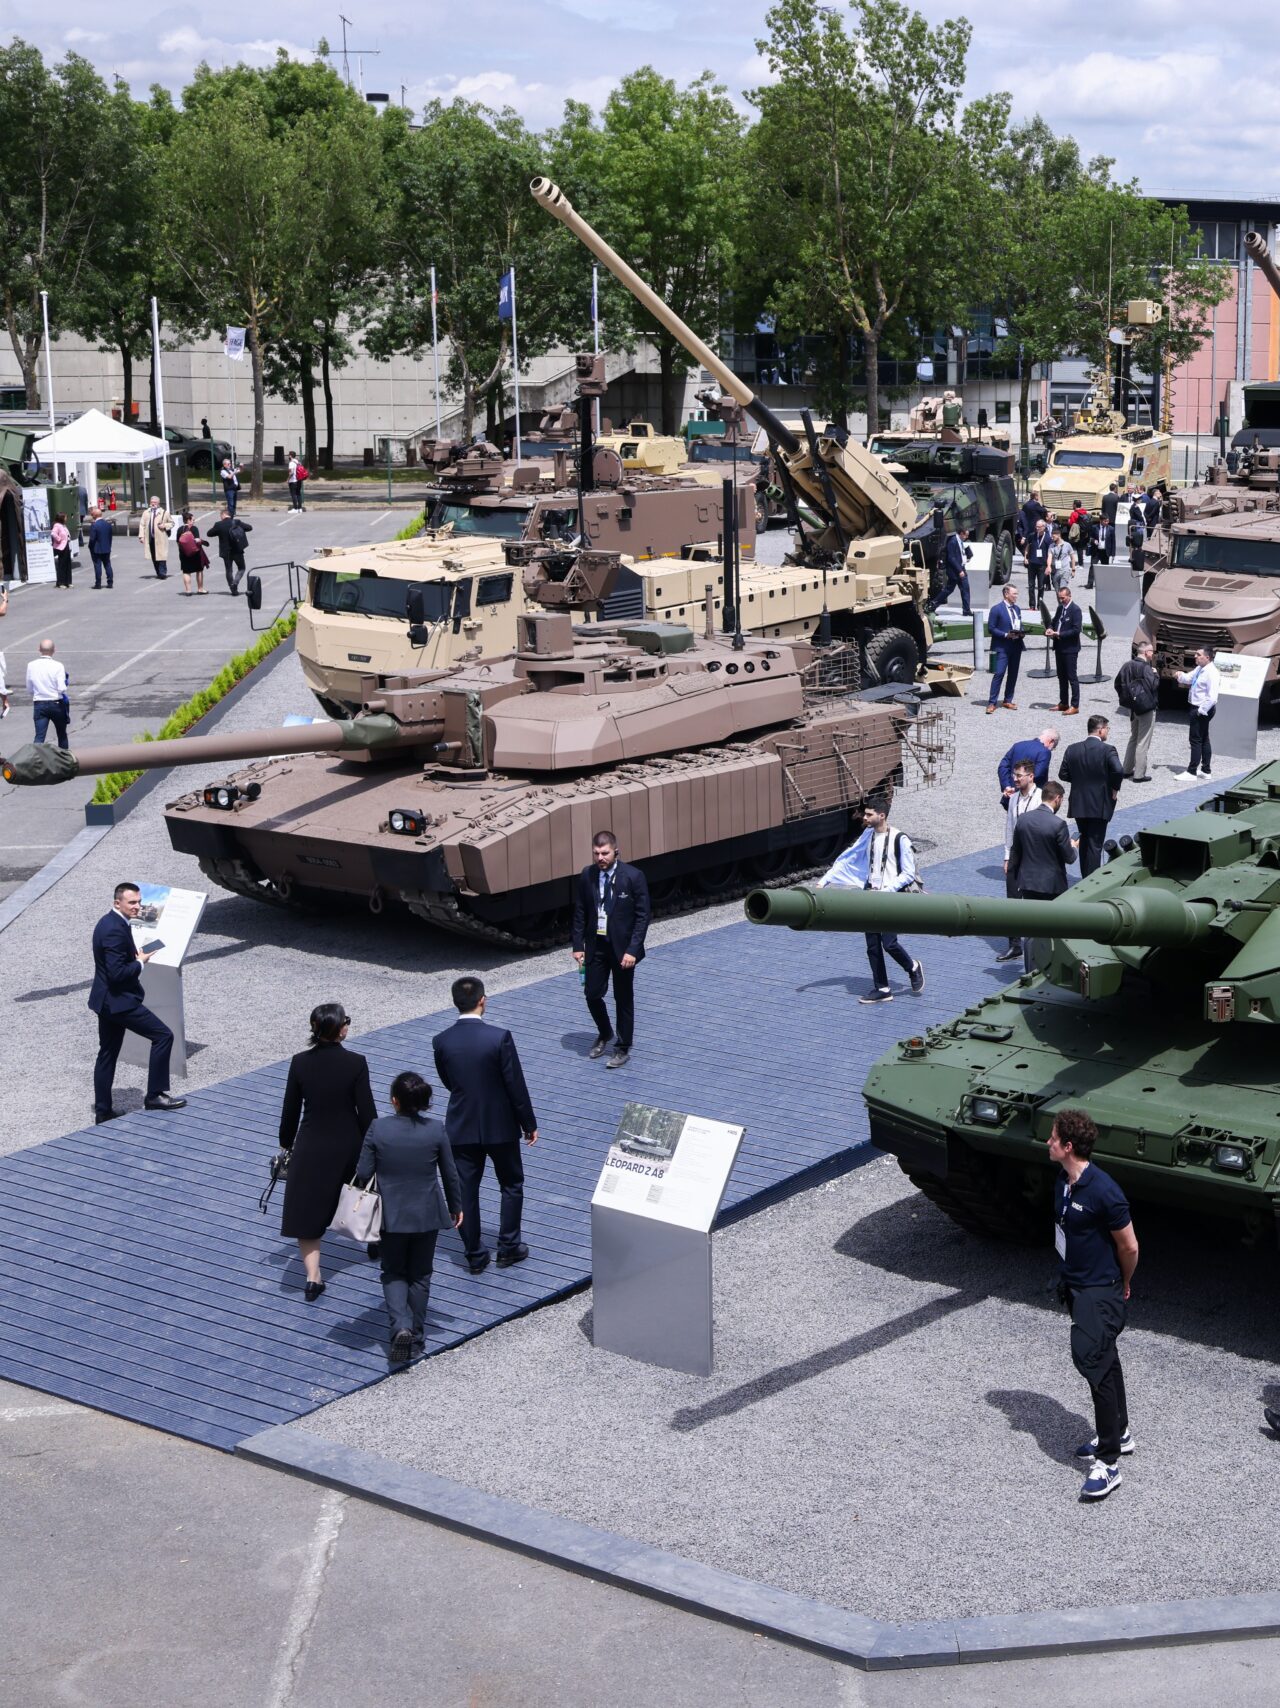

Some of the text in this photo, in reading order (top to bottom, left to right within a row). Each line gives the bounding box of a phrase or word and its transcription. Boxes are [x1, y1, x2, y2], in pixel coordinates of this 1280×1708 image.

[605, 1157, 664, 1179] LEOPARD 2 A8
